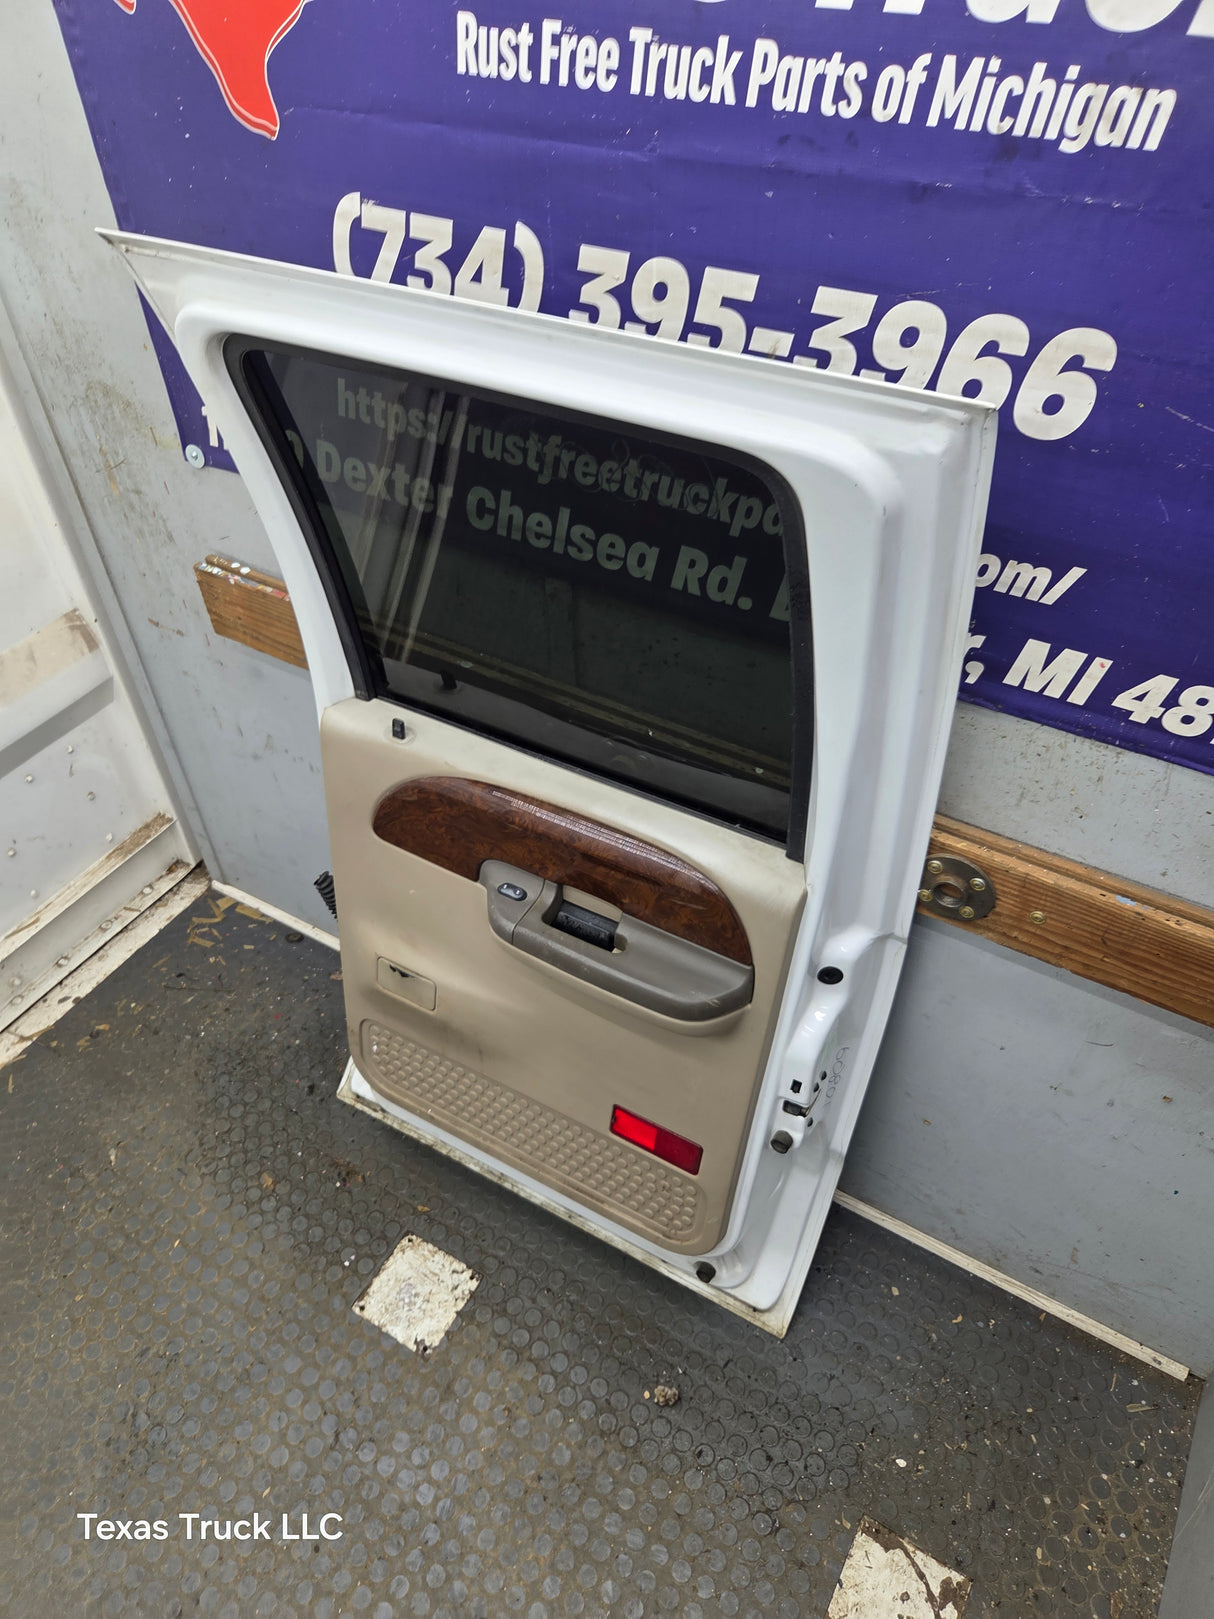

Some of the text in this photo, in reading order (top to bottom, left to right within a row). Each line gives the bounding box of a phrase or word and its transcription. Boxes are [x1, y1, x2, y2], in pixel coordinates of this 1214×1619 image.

[456, 10, 534, 84] Rust
[540, 18, 620, 93] Free
[629, 26, 743, 105] Truck
[745, 37, 868, 119] Parts
[872, 53, 933, 125] of
[926, 54, 1177, 154] Michigan
[333, 191, 1118, 441] (734) 395-3966
[316, 439, 453, 519] Dexter
[466, 486, 660, 582] Chelsea
[670, 545, 753, 610] Rd.
[1002, 638, 1114, 706] MI
[1111, 674, 1214, 744] 48
